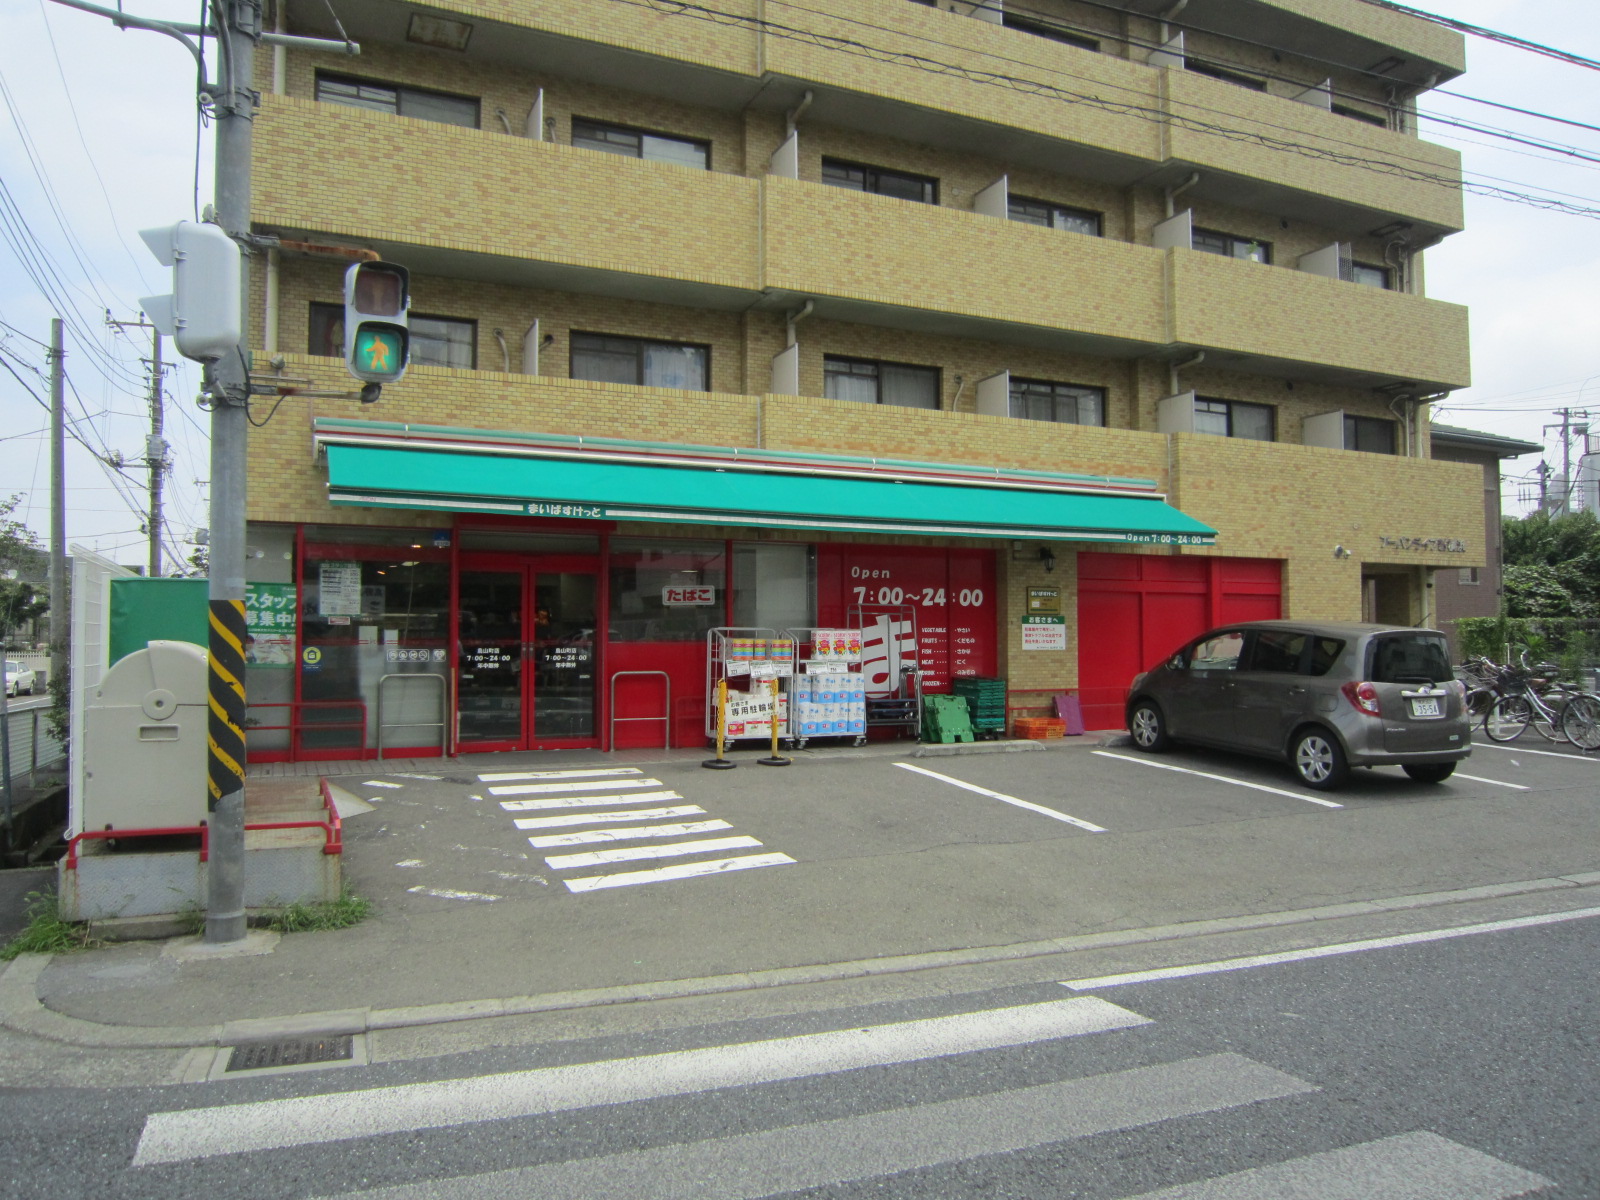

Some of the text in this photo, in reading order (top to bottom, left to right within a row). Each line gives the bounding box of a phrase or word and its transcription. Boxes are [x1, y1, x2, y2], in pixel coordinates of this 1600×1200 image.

[527, 503, 602, 518] まいばすけっと
[1127, 533, 1150, 542] Open
[851, 566, 891, 579] Open
[245, 593, 297, 609] スタッフ
[666, 588, 712, 602] たばこ
[853, 586, 983, 607] 7:00～24:00
